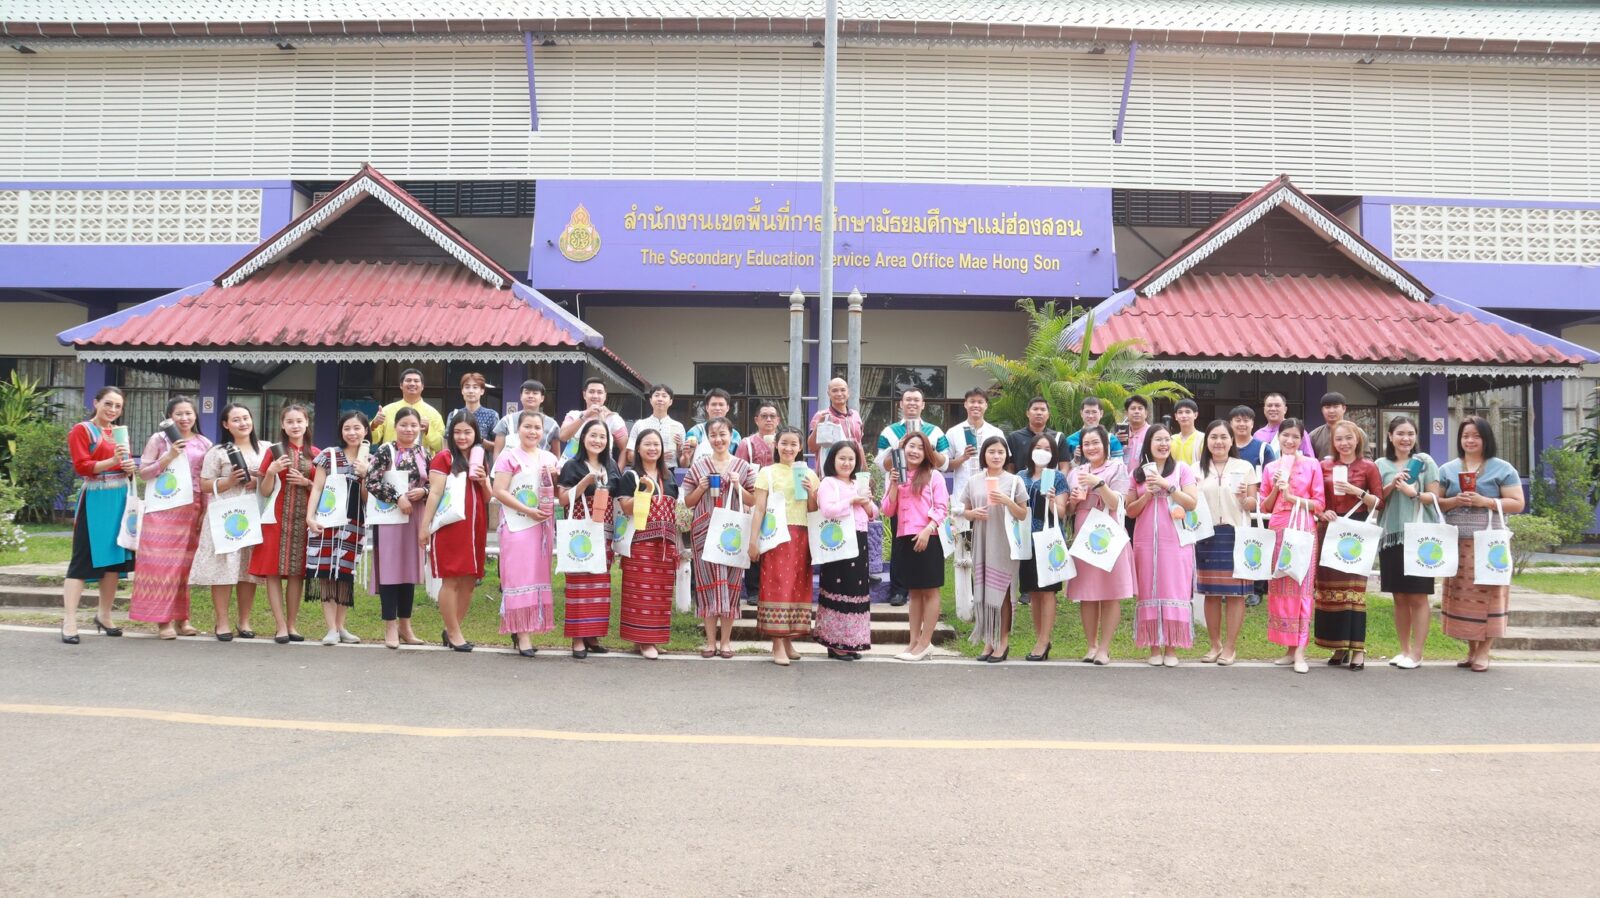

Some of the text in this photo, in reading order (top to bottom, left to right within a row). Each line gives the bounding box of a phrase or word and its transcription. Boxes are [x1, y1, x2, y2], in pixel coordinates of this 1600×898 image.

[624, 197, 1083, 237] สำนักงานเขตพื้นที่การกษามัธยมศึกษาแม่ฮ่องสอน
[640, 249, 1061, 274] The Secondary Education ervice Area Office Mae Hong Son
